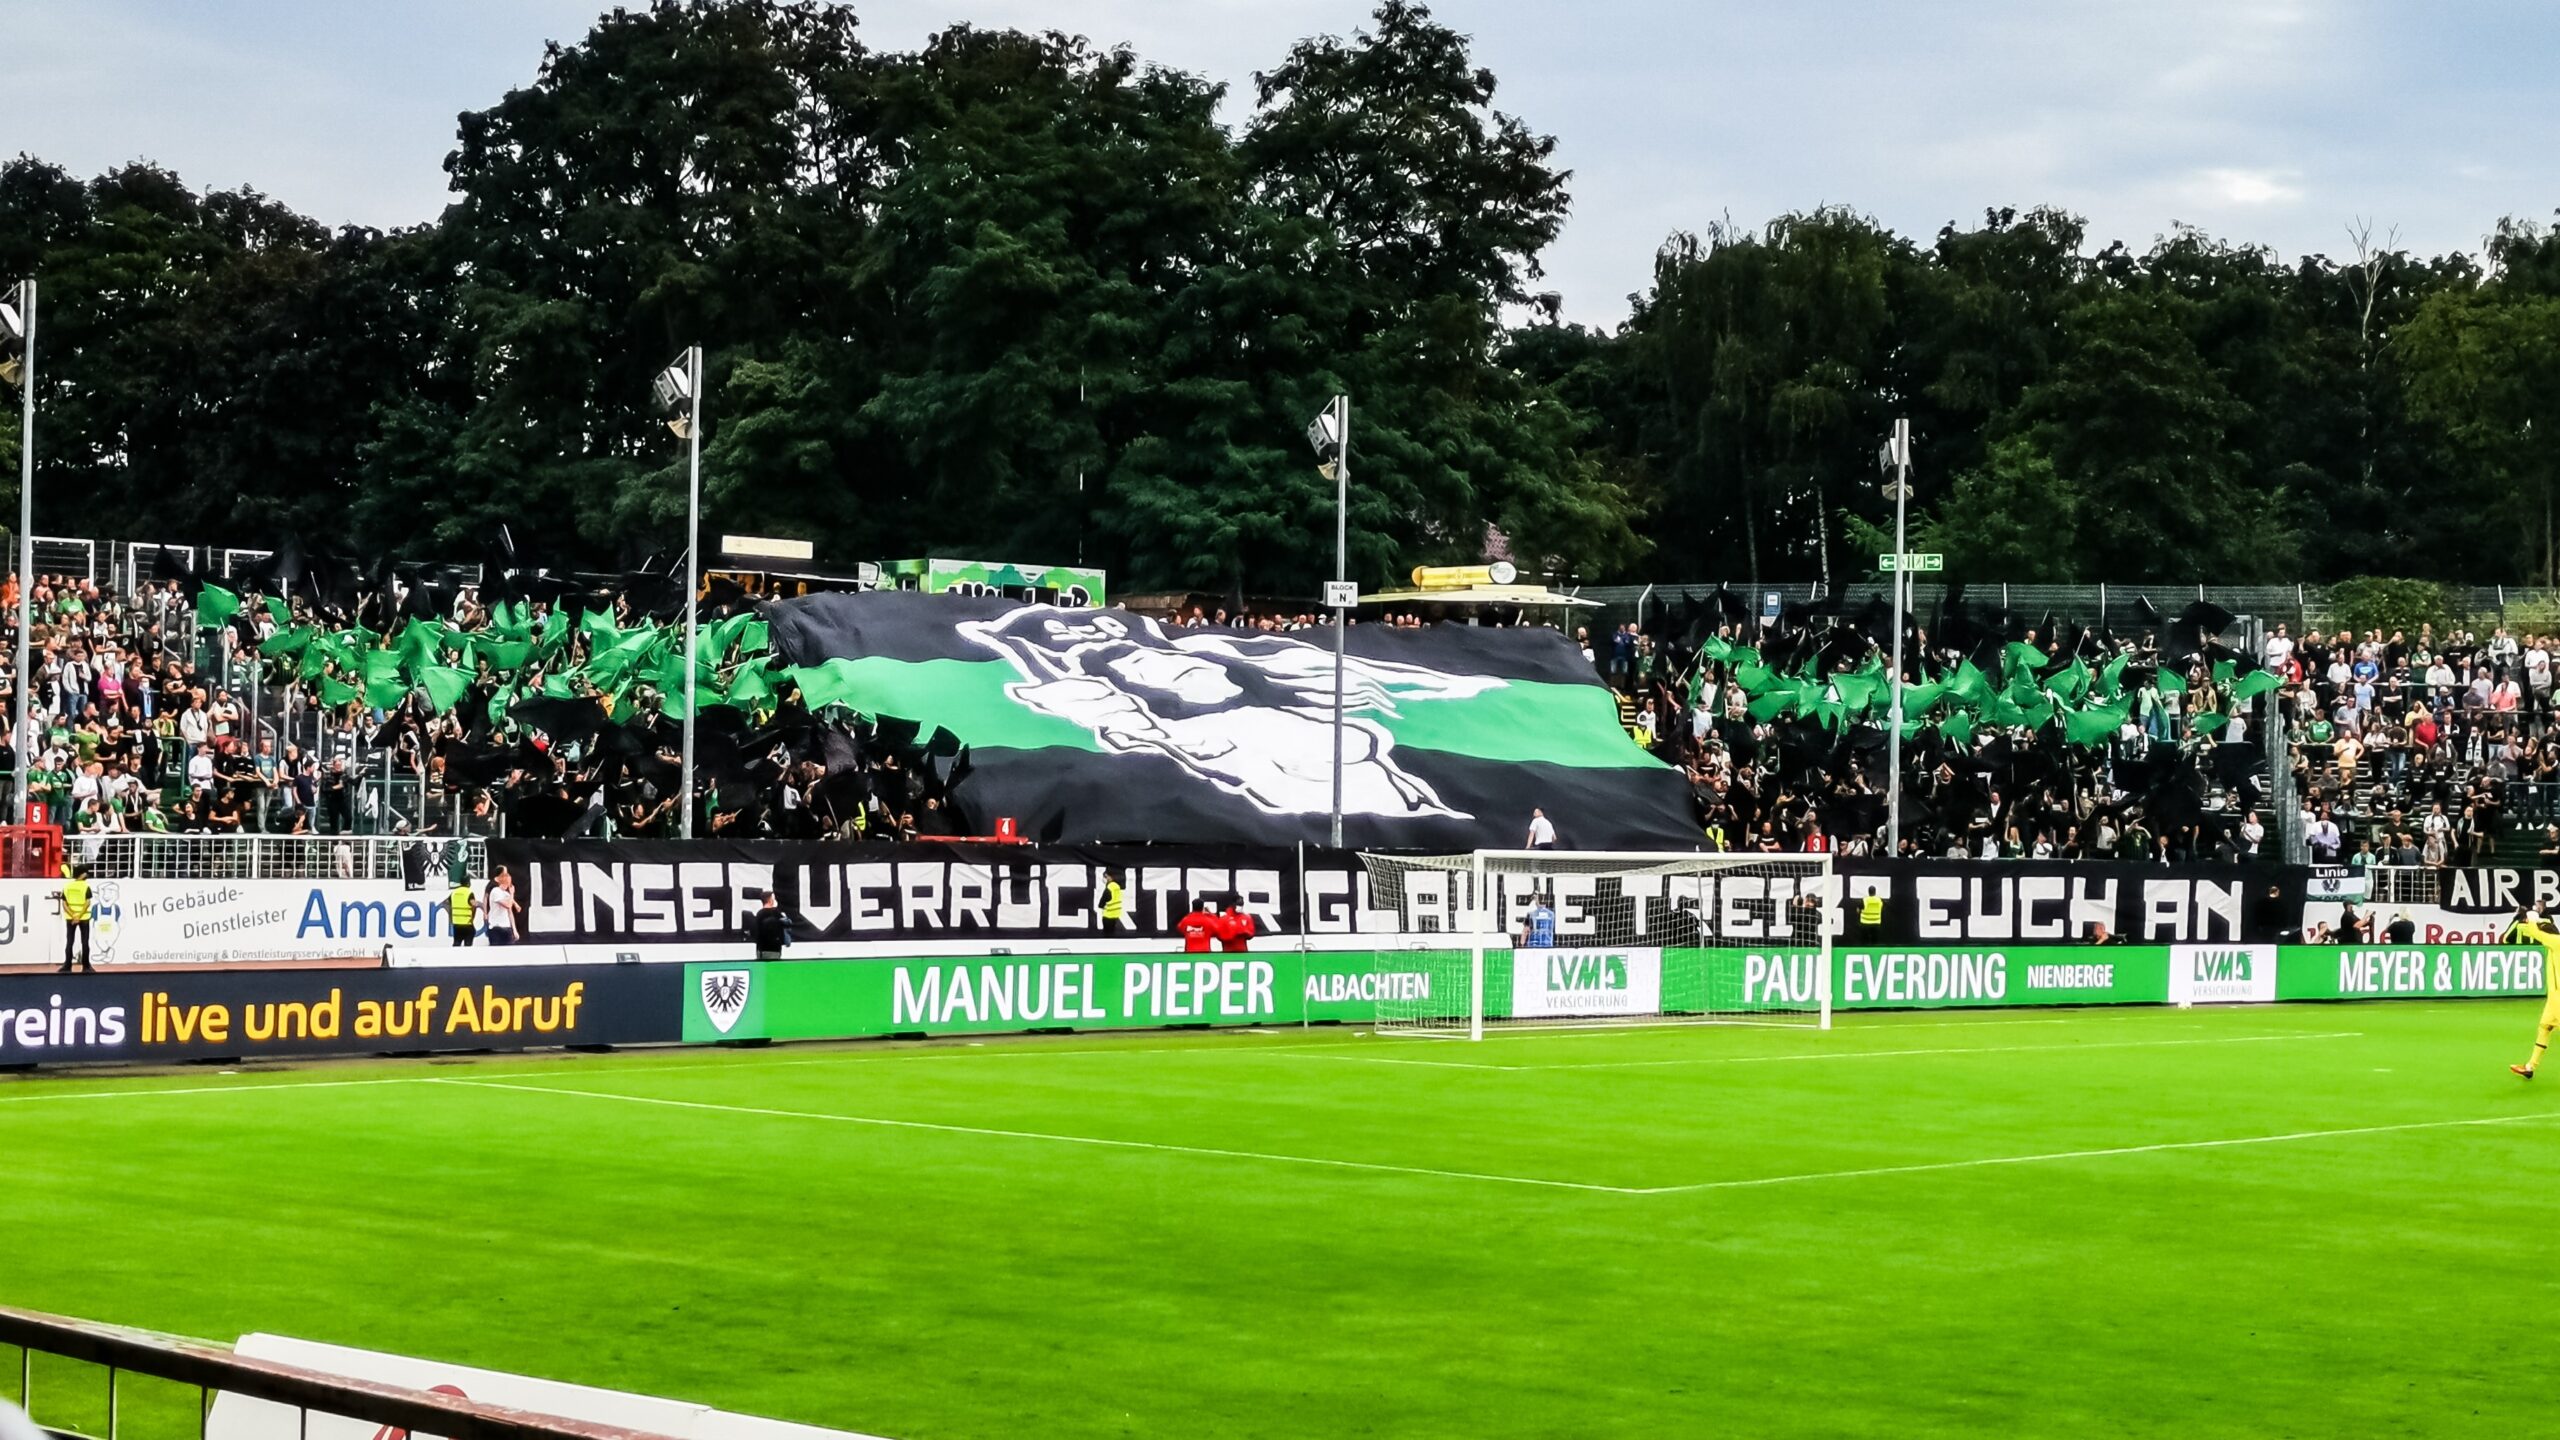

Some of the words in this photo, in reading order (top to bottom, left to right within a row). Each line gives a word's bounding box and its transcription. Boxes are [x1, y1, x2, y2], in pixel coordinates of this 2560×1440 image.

[1339, 593, 1347, 602] N
[33, 805, 41, 823] 5
[2315, 867, 2349, 877] Linie
[2450, 868, 2519, 907] AIR
[134, 901, 157, 918] Ihr
[162, 886, 244, 912] Gebäude-
[528, 861, 774, 932] UNSER
[1916, 876, 2117, 938] EUCH
[2144, 879, 2243, 941] AN
[183, 908, 288, 939] Dienstleister
[132, 950, 219, 961] Gebäudereinigung
[222, 949, 229, 959] &
[336, 948, 365, 957] GmbH
[1844, 953, 2006, 1000] EVERDING
[2027, 964, 2114, 988] NIENBERGE
[2339, 951, 2426, 992] MEYER
[2433, 952, 2453, 991] &
[2461, 951, 2543, 991] MEYER
[893, 963, 1105, 1023] MANUEL
[1123, 961, 1274, 1018] PIEPER
[1305, 972, 1429, 1001] ALBACHTEN
[1546, 995, 1628, 1008] VERSICHERUNG
[2193, 985, 2252, 996] VERSICHERUNG
[141, 992, 229, 1042] live
[244, 988, 340, 1039] und
[354, 985, 439, 1036] auf
[444, 982, 584, 1034] Abruf
